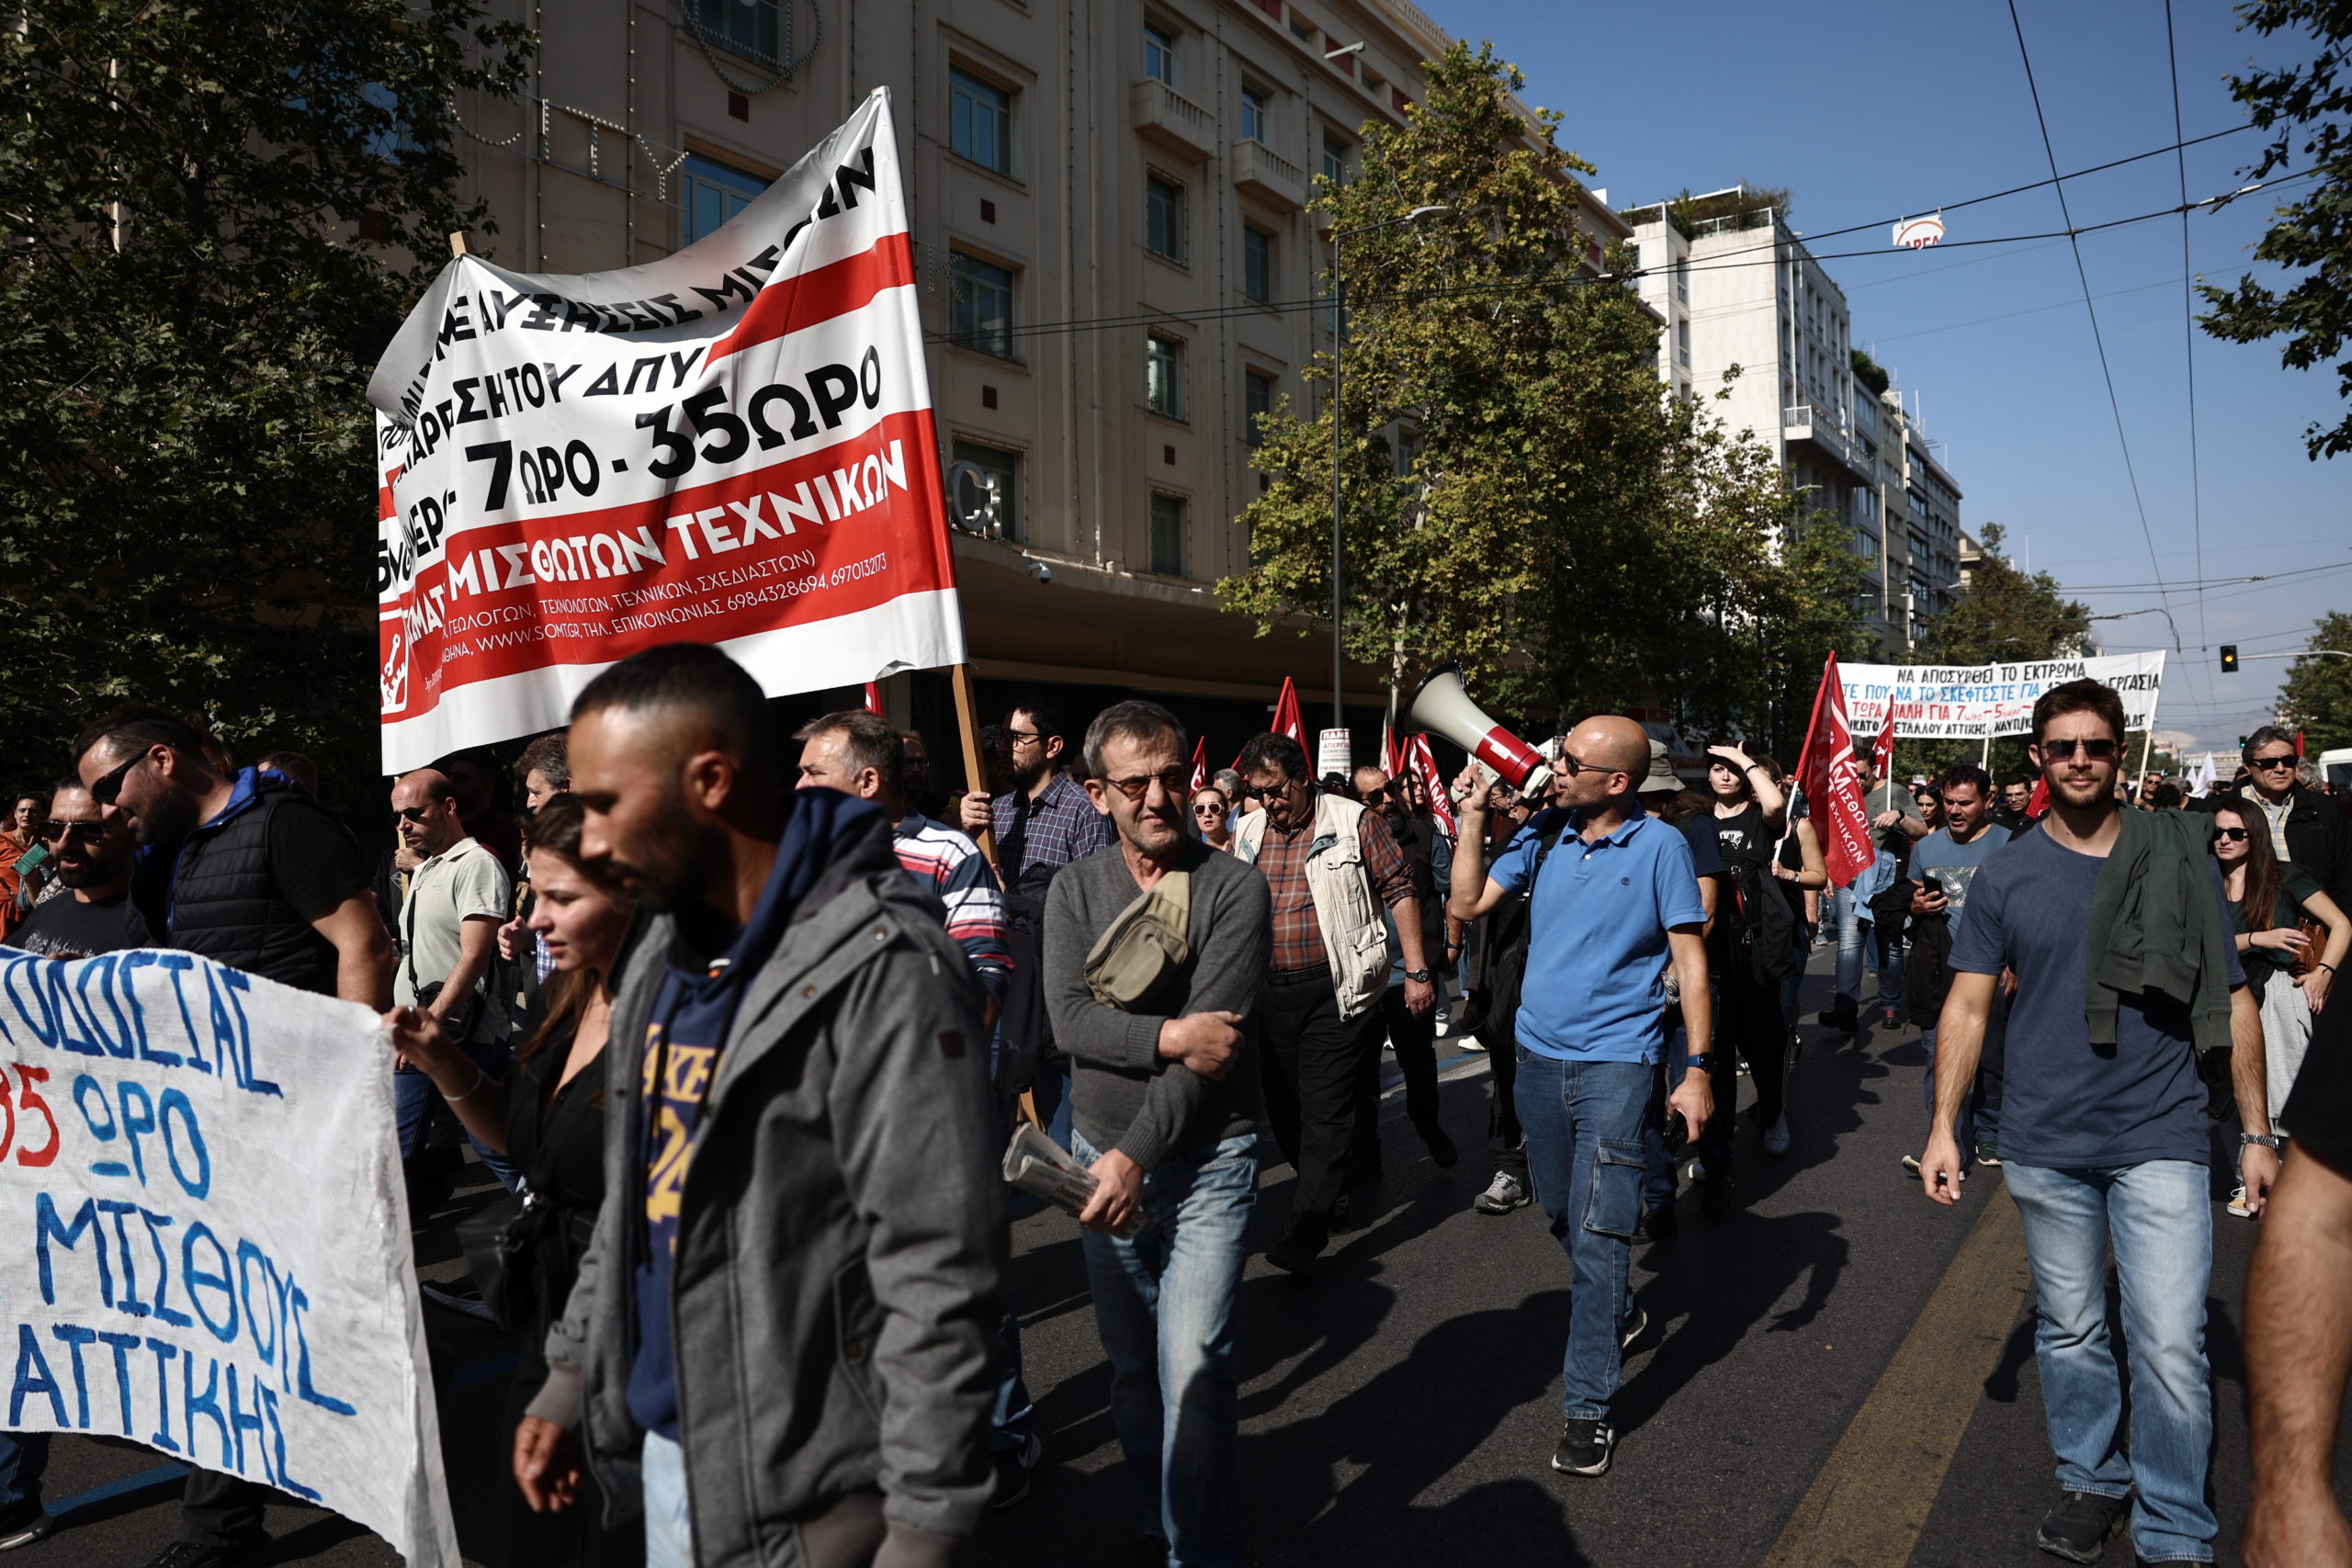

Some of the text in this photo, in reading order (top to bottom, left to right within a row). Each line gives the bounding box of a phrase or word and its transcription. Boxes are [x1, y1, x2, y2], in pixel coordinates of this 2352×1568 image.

[479, 289, 704, 335] ΑΥΞΗΣΕΙΣ
[503, 362, 583, 412] ΤΟΥ
[582, 346, 706, 398] ΔΠΥ
[465, 438, 600, 513] 7ΩΡΟ
[635, 344, 881, 479] 35ΩΡΟ
[447, 525, 668, 602] ΜΙΣΘΩΤΩΝ
[666, 439, 909, 560] ΤΕΧΝΙΚΩΝ
[611, 599, 725, 634] ΕΠΙΚΟΙΝΩΝΙΑΣ
[831, 552, 888, 586] 6970132173
[697, 549, 816, 592] ΣΧΕΔΙΑΣΤΩΝ)
[1866, 684, 1891, 700] ΠΟΥ
[1895, 686, 1912, 701] ΝΑ
[1919, 687, 1935, 701] ΤΟ
[1940, 684, 2015, 702] ΣΚΕΦΤΕΣΤΕ
[2020, 683, 2041, 698] ΓΙΑ
[1897, 669, 1915, 683] ΝΑ
[1921, 668, 1993, 683] ΑΠΟΣΥΡΘΕΙ
[2001, 666, 2017, 682] ΤΟ
[1852, 701, 1883, 717] ΤΩΡΑ
[1930, 705, 1950, 720] ΓΙΑ
[1894, 721, 1942, 735] ΕΤΑΛΛΟΥ
[36, 1191, 357, 1416] ΜΙΣΘΟΥΣ
[9, 1323, 323, 1502] ΑΤΤΙΚΗΣ
